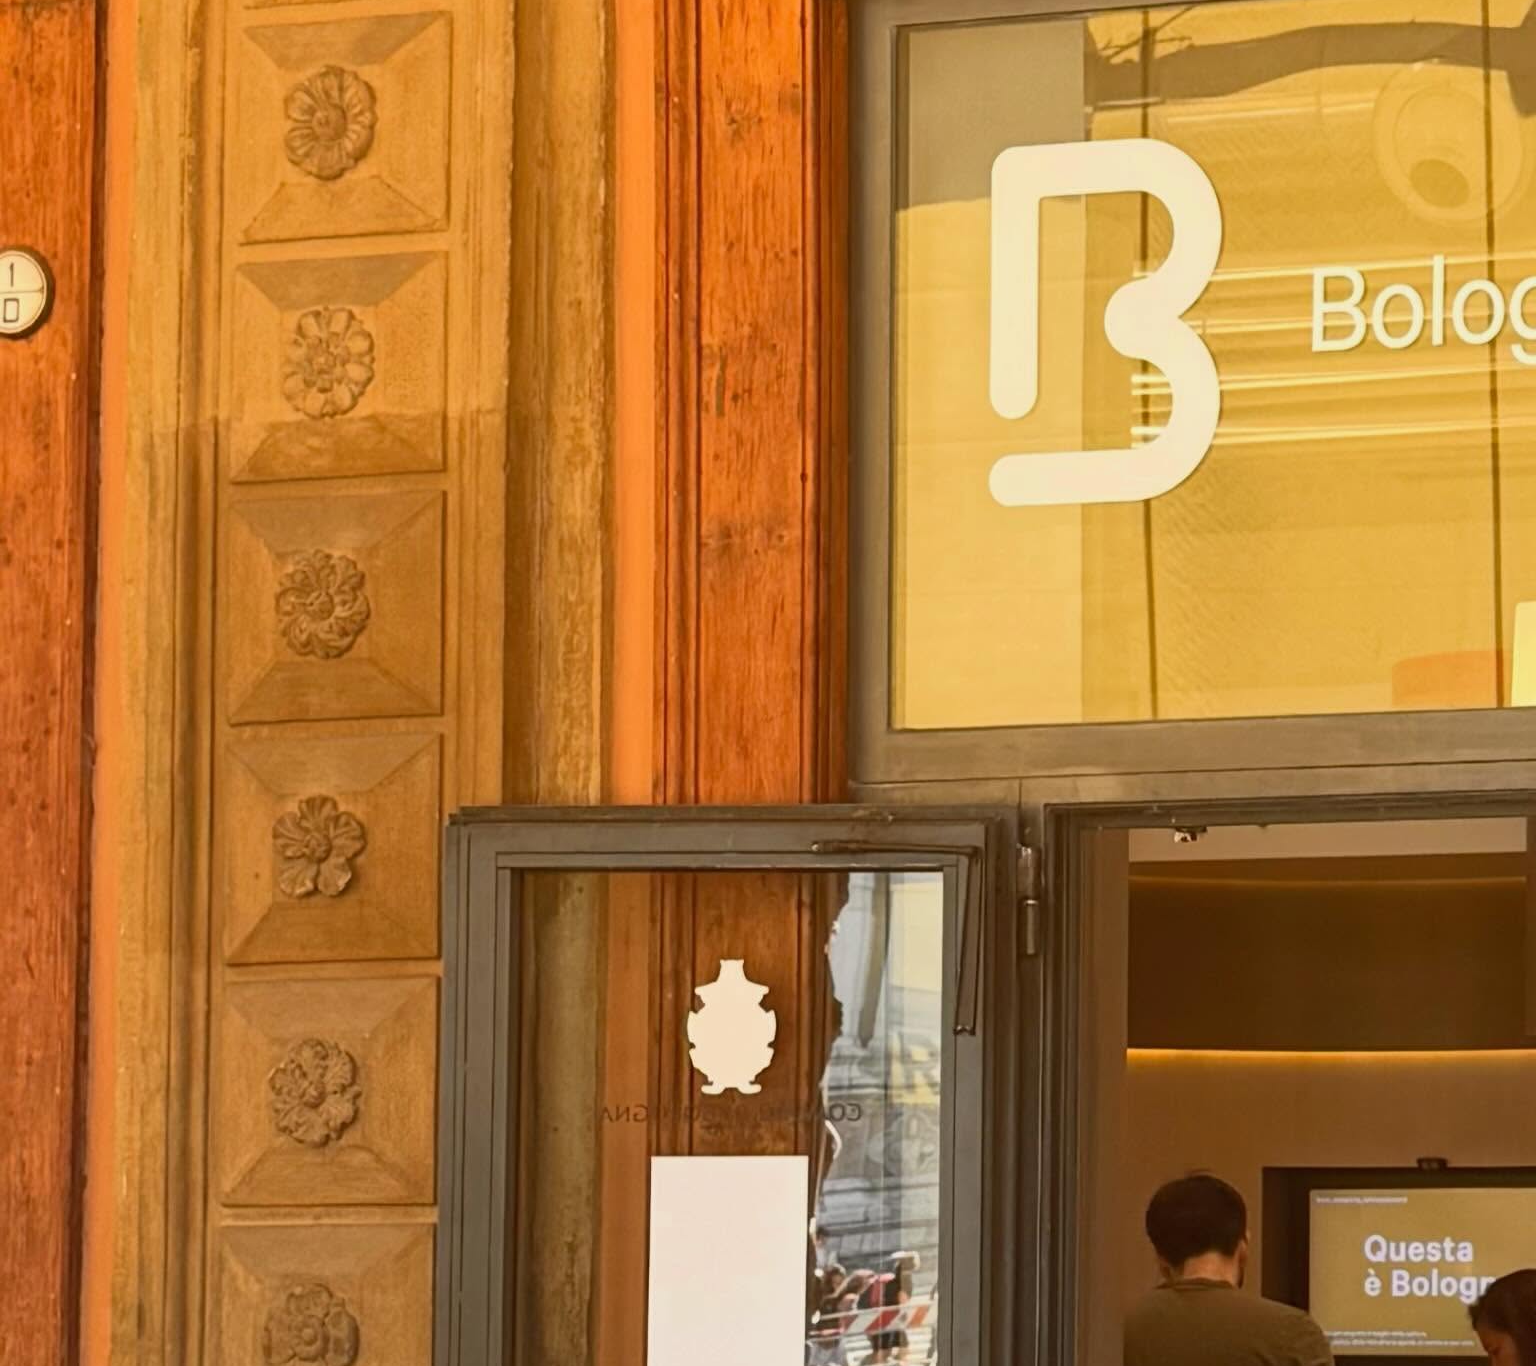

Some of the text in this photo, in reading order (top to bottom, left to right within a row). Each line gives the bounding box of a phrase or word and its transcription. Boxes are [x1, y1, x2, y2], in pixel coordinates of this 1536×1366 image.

[1364, 1235, 1473, 1263] Questa
[1364, 1269, 1496, 1305] è Bolog
